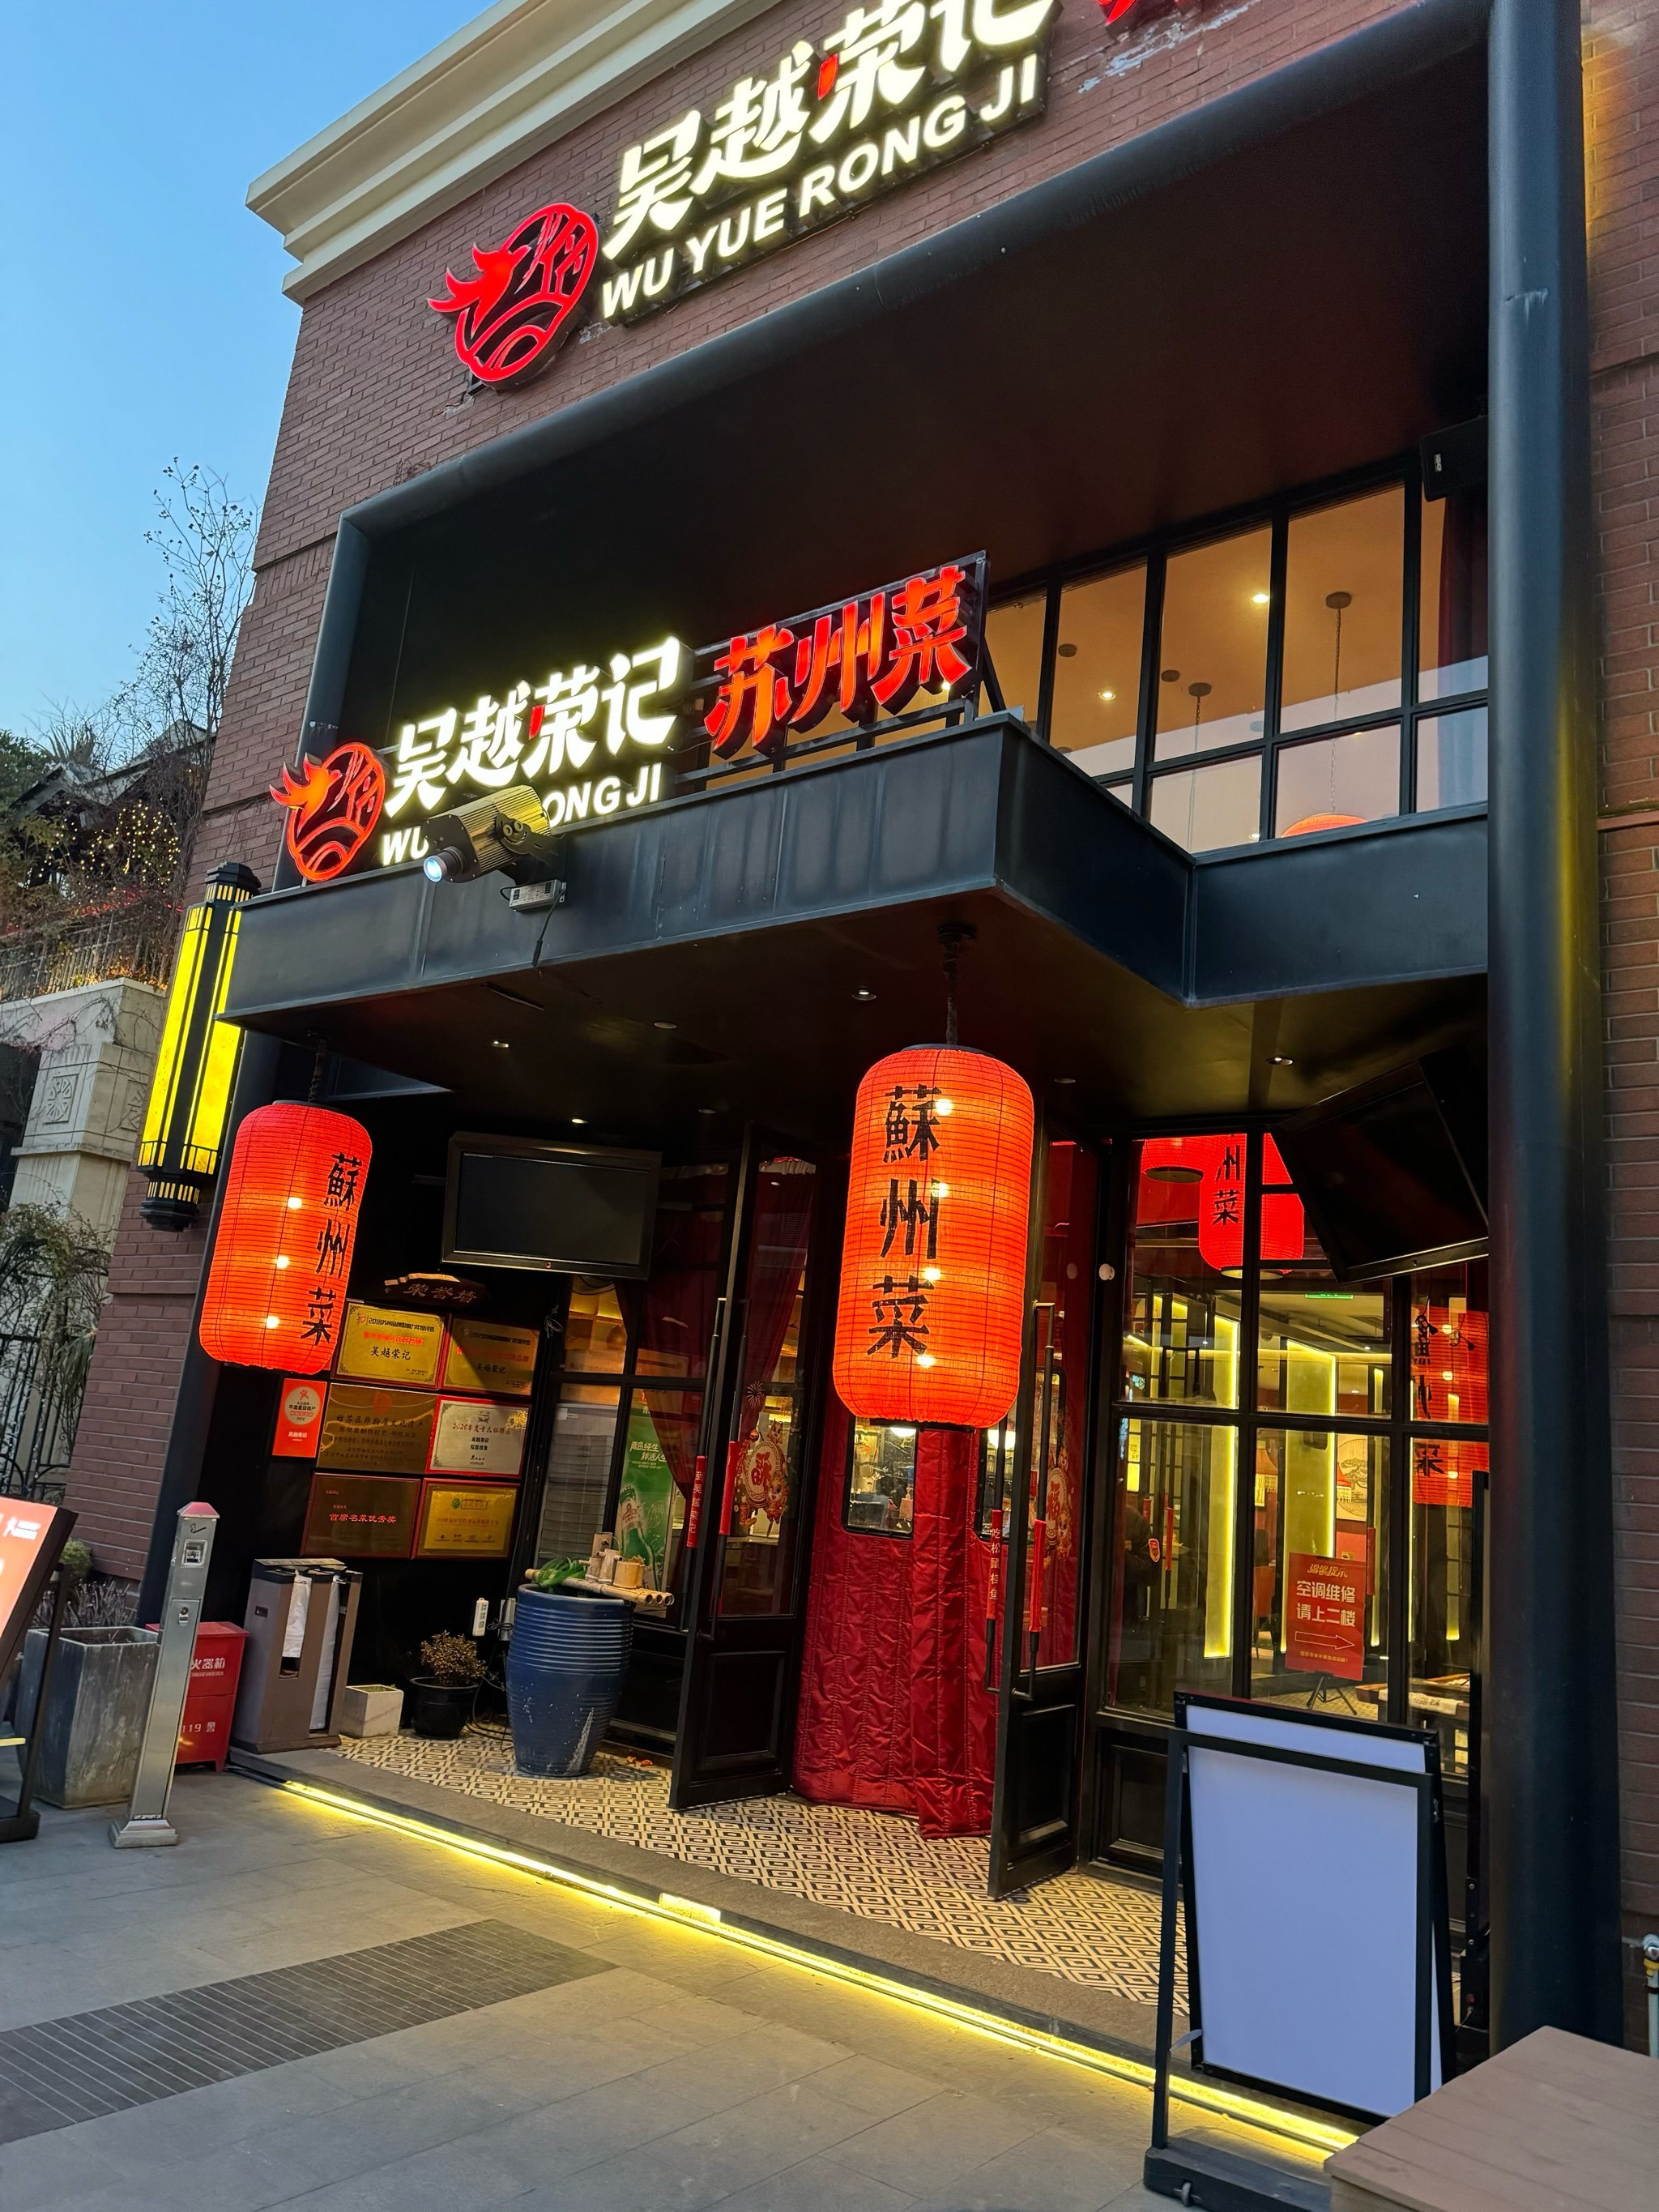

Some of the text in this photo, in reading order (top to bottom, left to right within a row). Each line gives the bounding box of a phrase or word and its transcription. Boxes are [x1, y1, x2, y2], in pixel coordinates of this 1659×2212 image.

[602, 53, 1037, 319] WU YUE RONG JI
[706, 566, 974, 755] 苏州菜
[384, 636, 680, 819] 吴越荣记
[382, 762, 662, 866] WU ONG JI
[867, 1083, 943, 1360] 蘇州菜
[1211, 1134, 1241, 1227] 州菜
[300, 1151, 363, 1347] 蘇州菜
[403, 1283, 477, 1304] 荣誉墙
[371, 1346, 411, 1360] 吴越荣记
[1296, 1580, 1355, 1603] 空调维修
[1296, 1603, 1355, 1627] 请上二楼
[190, 1657, 225, 1670] 火器箱
